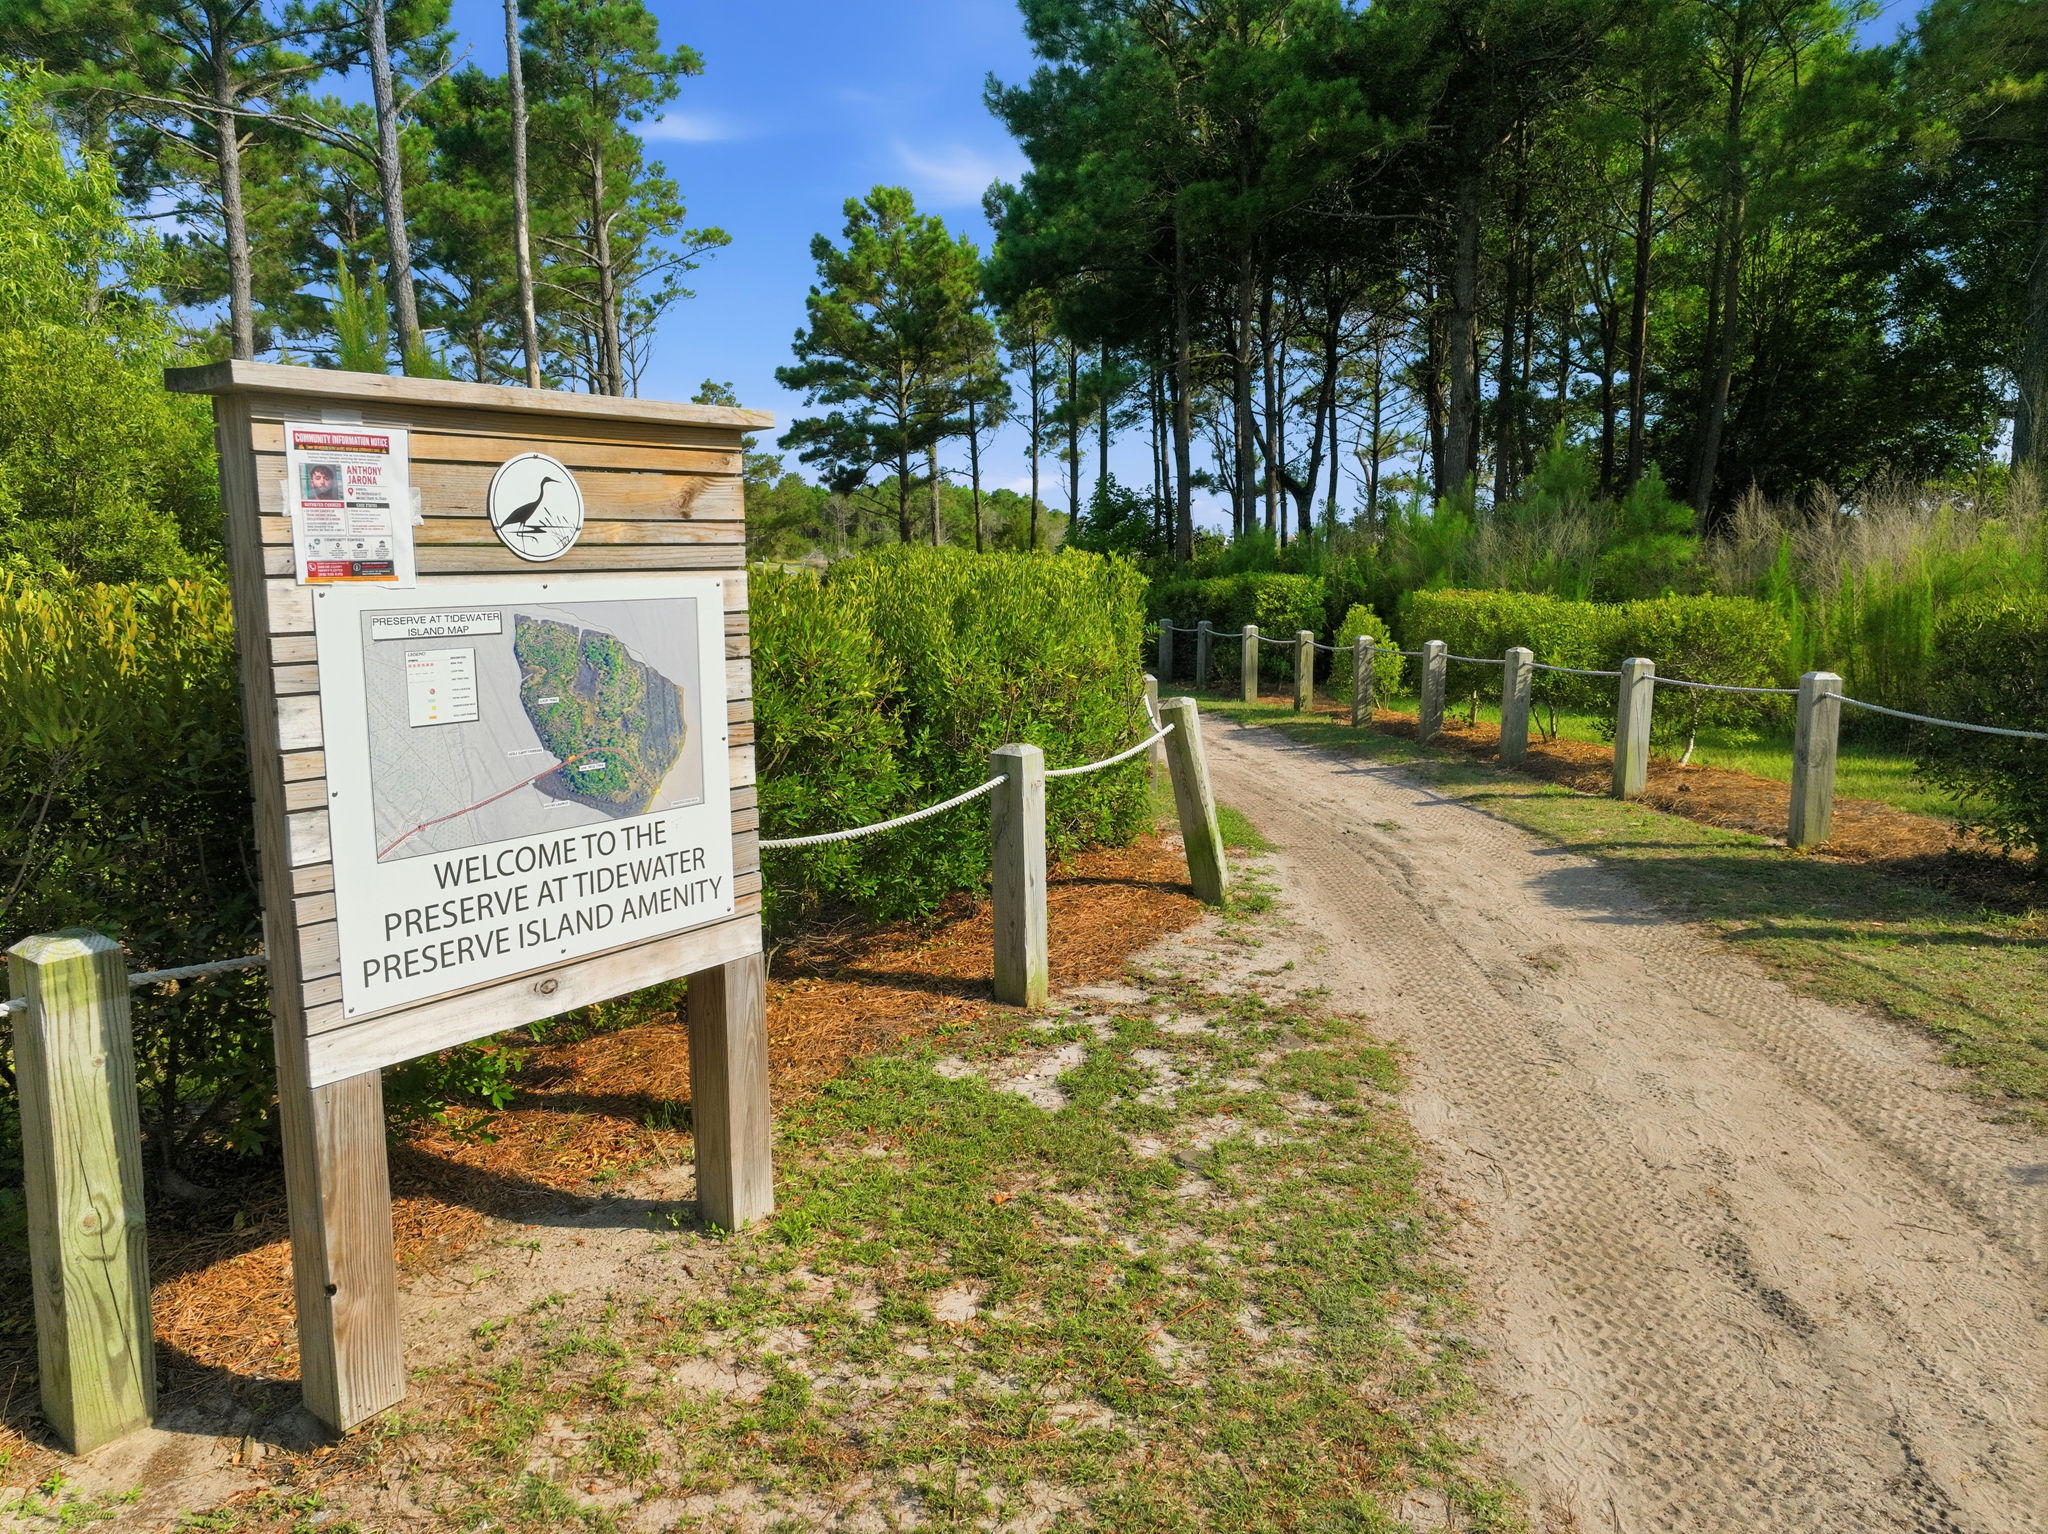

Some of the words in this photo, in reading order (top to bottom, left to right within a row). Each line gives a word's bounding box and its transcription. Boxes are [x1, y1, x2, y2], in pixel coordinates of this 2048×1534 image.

[295, 432, 331, 444] COMMUNITY
[332, 435, 370, 446] INFORMATION
[370, 437, 388, 448] NOTICE
[346, 465, 382, 476] ANTHONY
[347, 475, 378, 485] JARONA
[372, 616, 427, 626] PRESERVE
[429, 615, 442, 624] AT
[444, 613, 500, 623] TIDEWATER
[408, 627, 445, 637] ISLAND
[447, 626, 469, 635] MAP
[433, 838, 577, 890] WELCOME
[581, 831, 616, 859] TO
[621, 820, 667, 851] THE
[384, 885, 529, 942] PRESERVE
[537, 876, 568, 908] AT
[572, 847, 706, 898] TIDEWATER
[363, 927, 511, 988] PRESERVE
[518, 903, 614, 949] ISLAND
[621, 876, 722, 923] AMENITY
